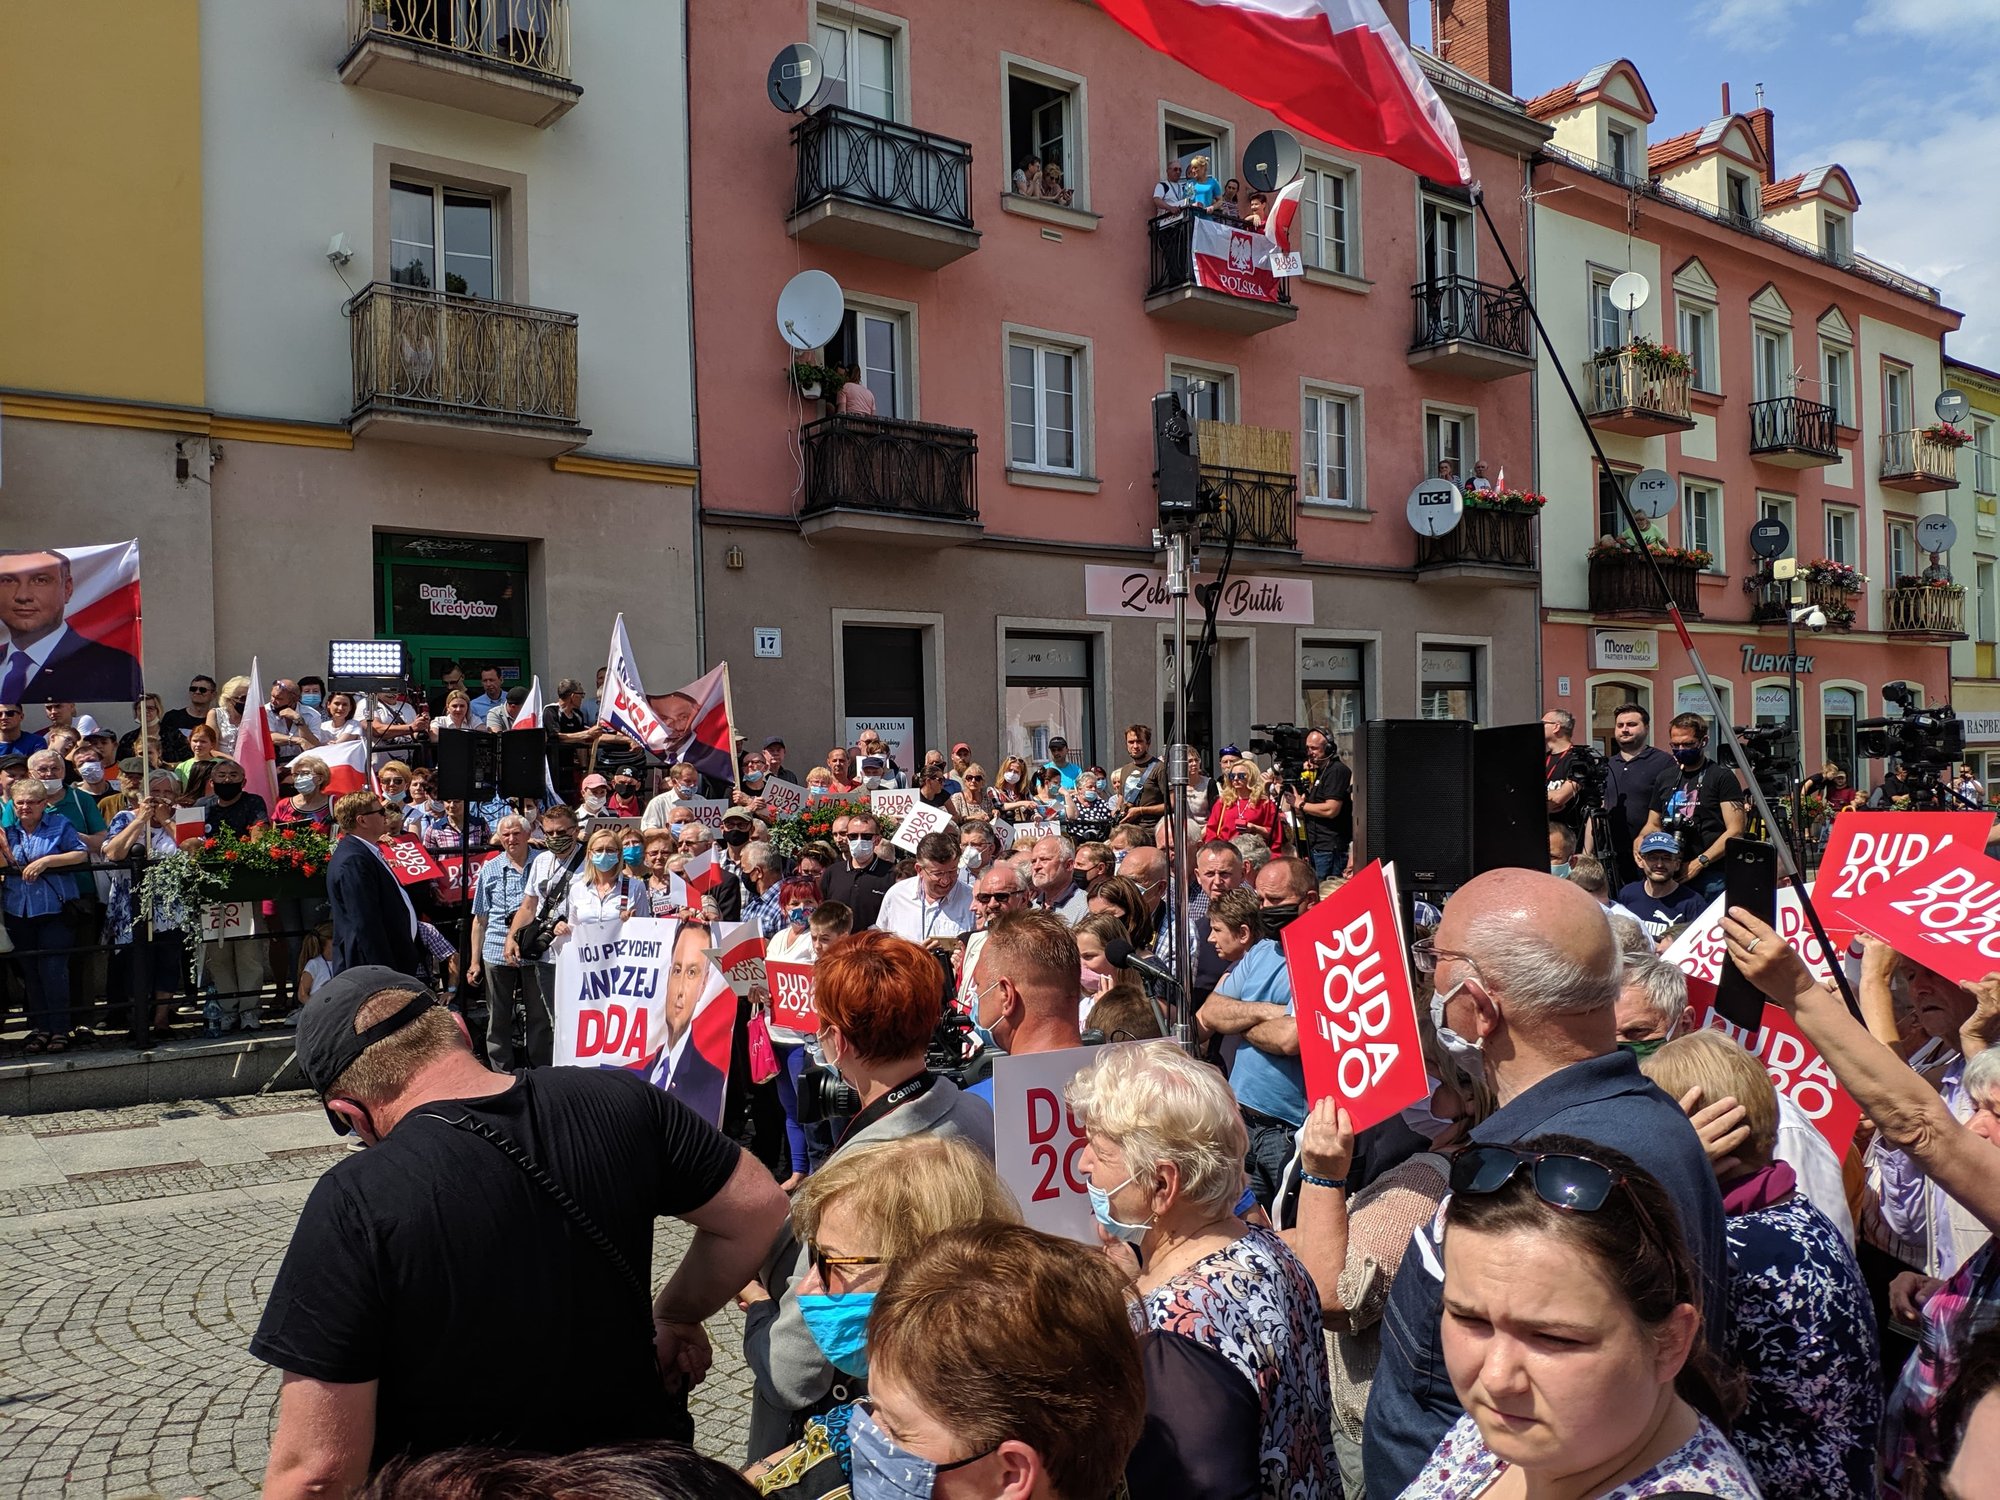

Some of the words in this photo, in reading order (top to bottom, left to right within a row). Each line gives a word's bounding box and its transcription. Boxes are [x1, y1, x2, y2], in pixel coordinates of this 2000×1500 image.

[1274, 255, 1297, 264] DUDA
[1277, 261, 1299, 270] 2020
[1219, 274, 1266, 297] POLSKA
[1640, 480, 1666, 490] nc+
[1420, 492, 1449, 504] nc+
[1925, 522, 1948, 531] nc+
[420, 584, 456, 600] Bank
[1224, 579, 1285, 617] Butik
[430, 600, 498, 620] Kredytów
[760, 636, 776, 650] 17
[1756, 689, 1784, 703] moda
[855, 722, 905, 731] SOLARIUM
[770, 784, 800, 801] DUDA
[878, 795, 914, 806] DUDA
[901, 811, 931, 842] DUDA
[1021, 827, 1054, 837] DUDA
[1649, 836, 1669, 844] NIKE
[391, 843, 422, 876] 2020
[402, 841, 431, 874] DUDA
[1342, 909, 1400, 1088] DUDA
[1314, 929, 1371, 1099] 2020
[887, 1080, 922, 1103] Canon
